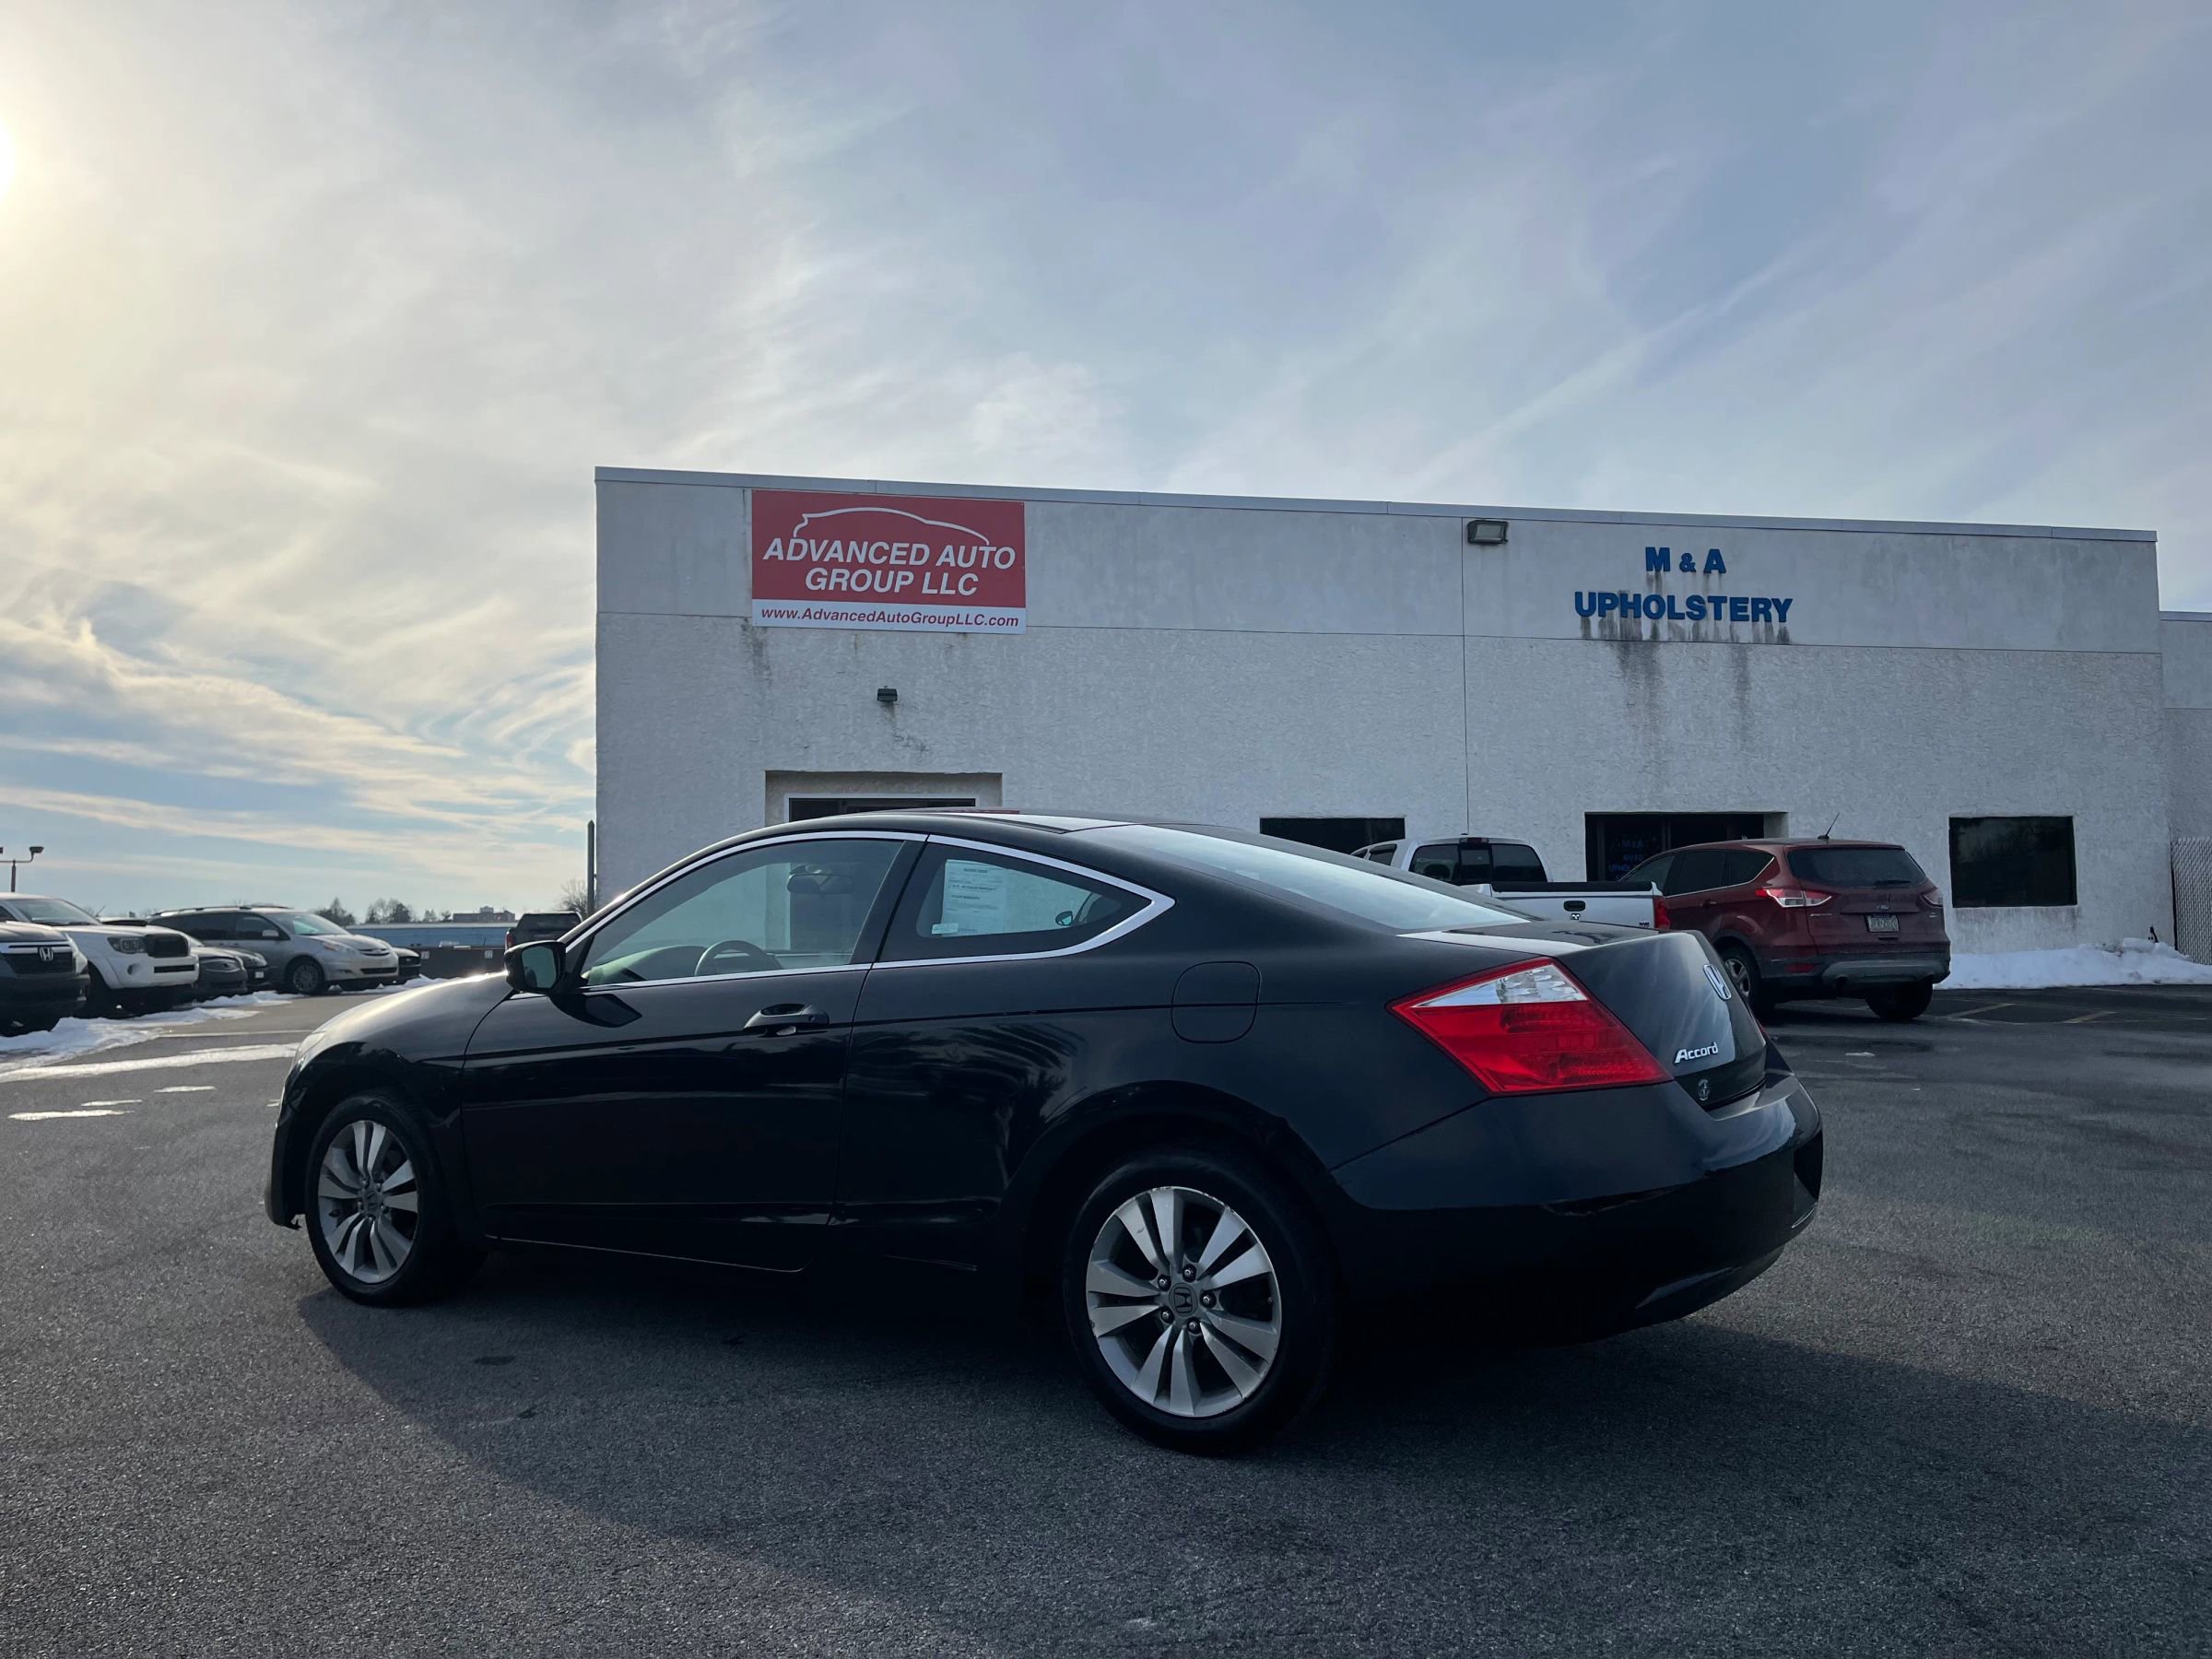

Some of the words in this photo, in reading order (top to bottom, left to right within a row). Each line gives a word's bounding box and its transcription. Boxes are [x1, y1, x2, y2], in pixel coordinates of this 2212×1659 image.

[762, 537, 930, 566] ADVANCED
[935, 545, 1016, 570] AUTO
[1645, 547, 1671, 572] M
[1679, 552, 1697, 573] &
[1703, 548, 1726, 573] A
[805, 567, 914, 594] GROUP
[921, 571, 979, 595] LLC
[760, 606, 1018, 628] www.AdvancedAutoGroupLLC.com
[1574, 591, 1794, 622] UPHOLSTERY
[1675, 1041, 1719, 1064] Accord
